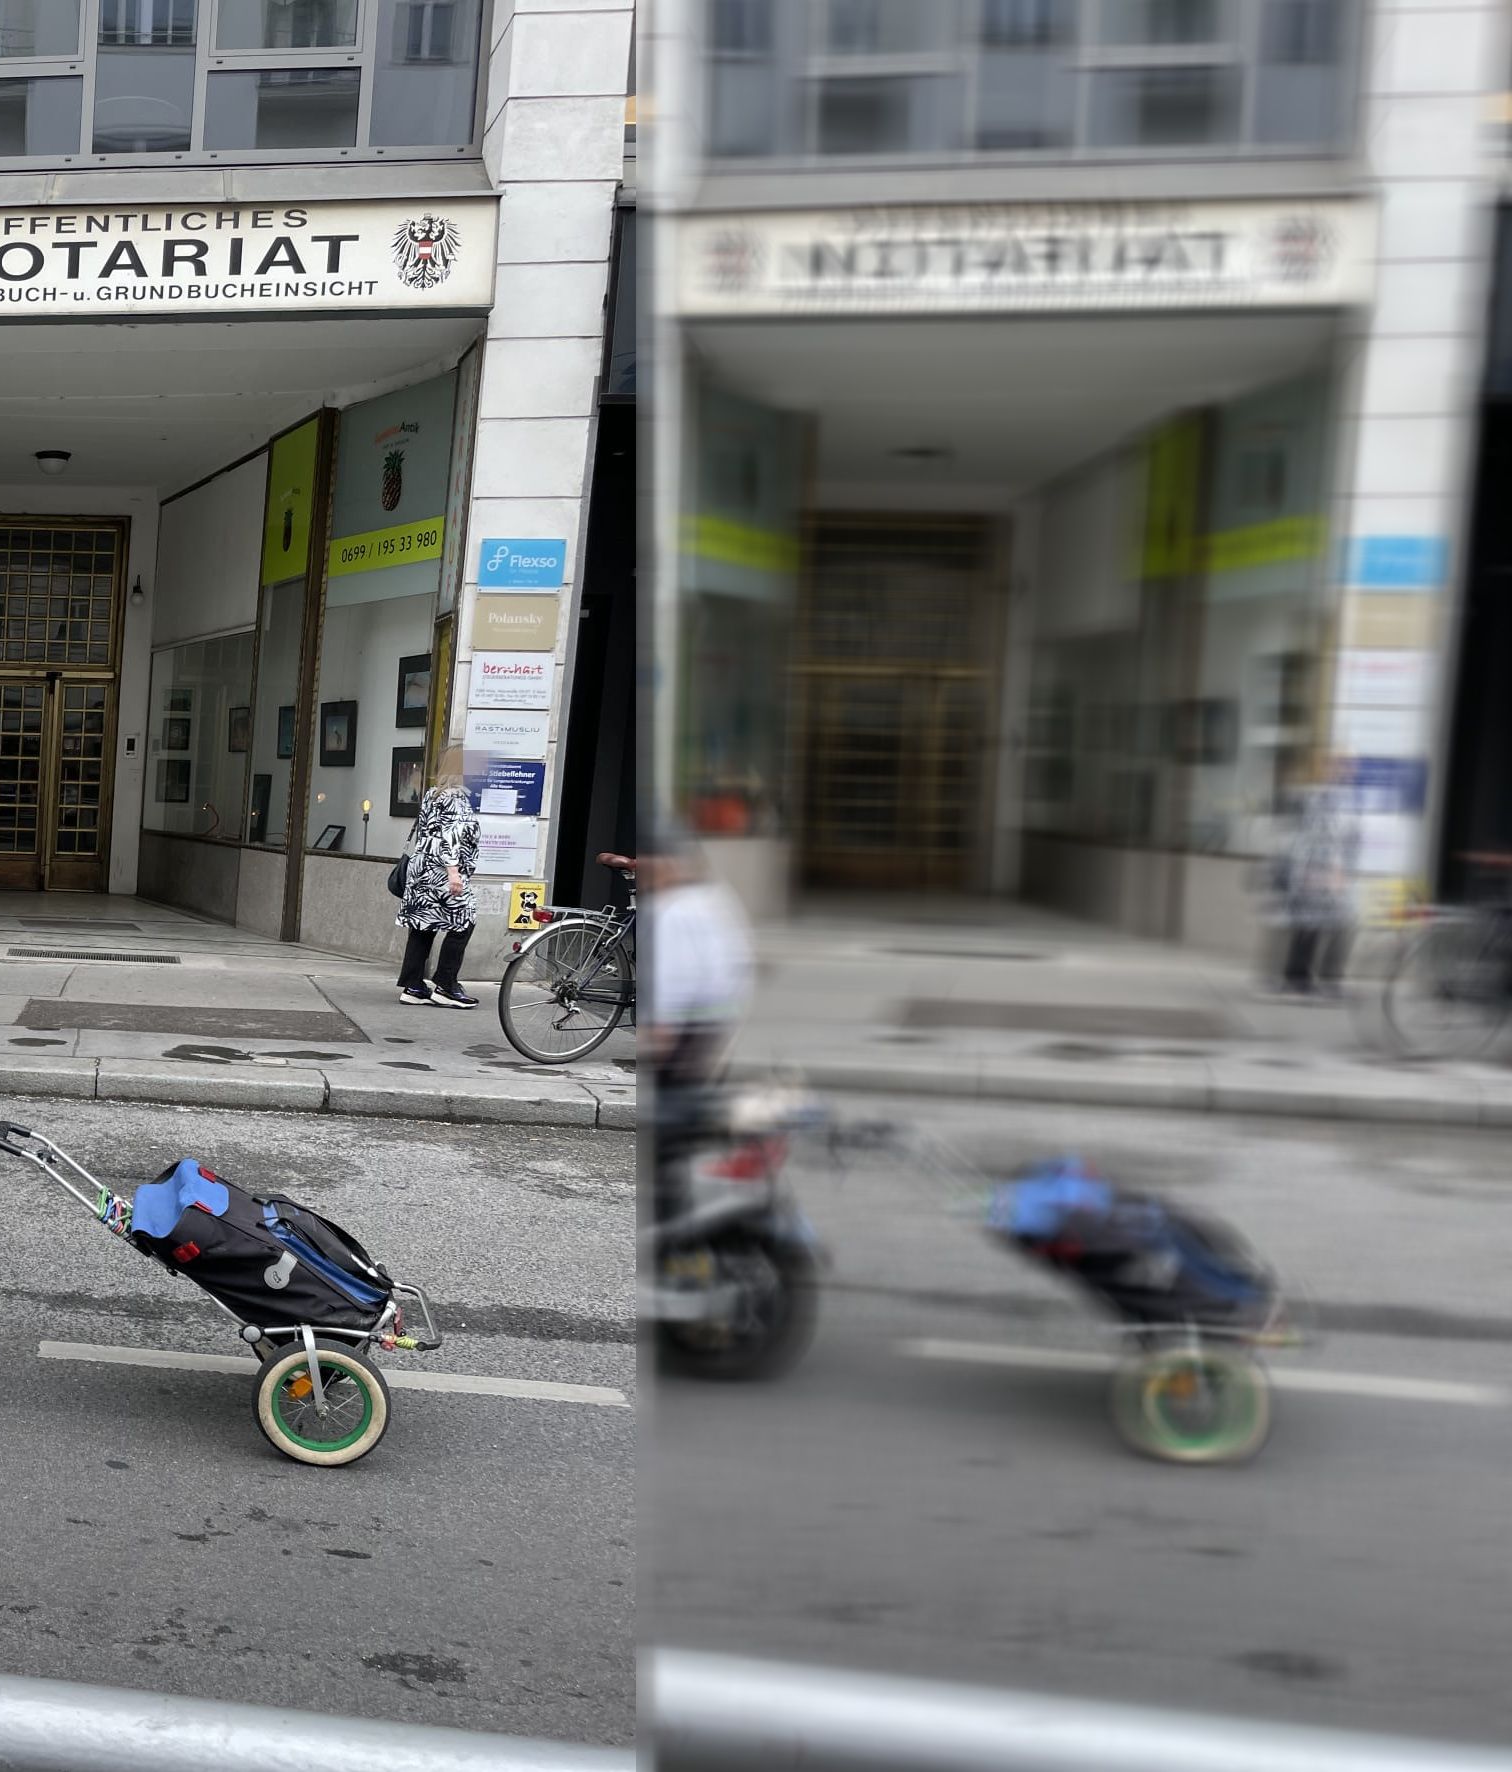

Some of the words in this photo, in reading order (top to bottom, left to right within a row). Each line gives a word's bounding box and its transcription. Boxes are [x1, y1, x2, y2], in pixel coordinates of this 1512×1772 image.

[96, 281, 378, 301] GRUNDBUCHEINSICHT
[341, 544, 366, 563] 0699
[378, 539, 396, 556] 195
[399, 535, 412, 552] 33
[416, 530, 437, 549] 980
[510, 554, 558, 568] Flexso
